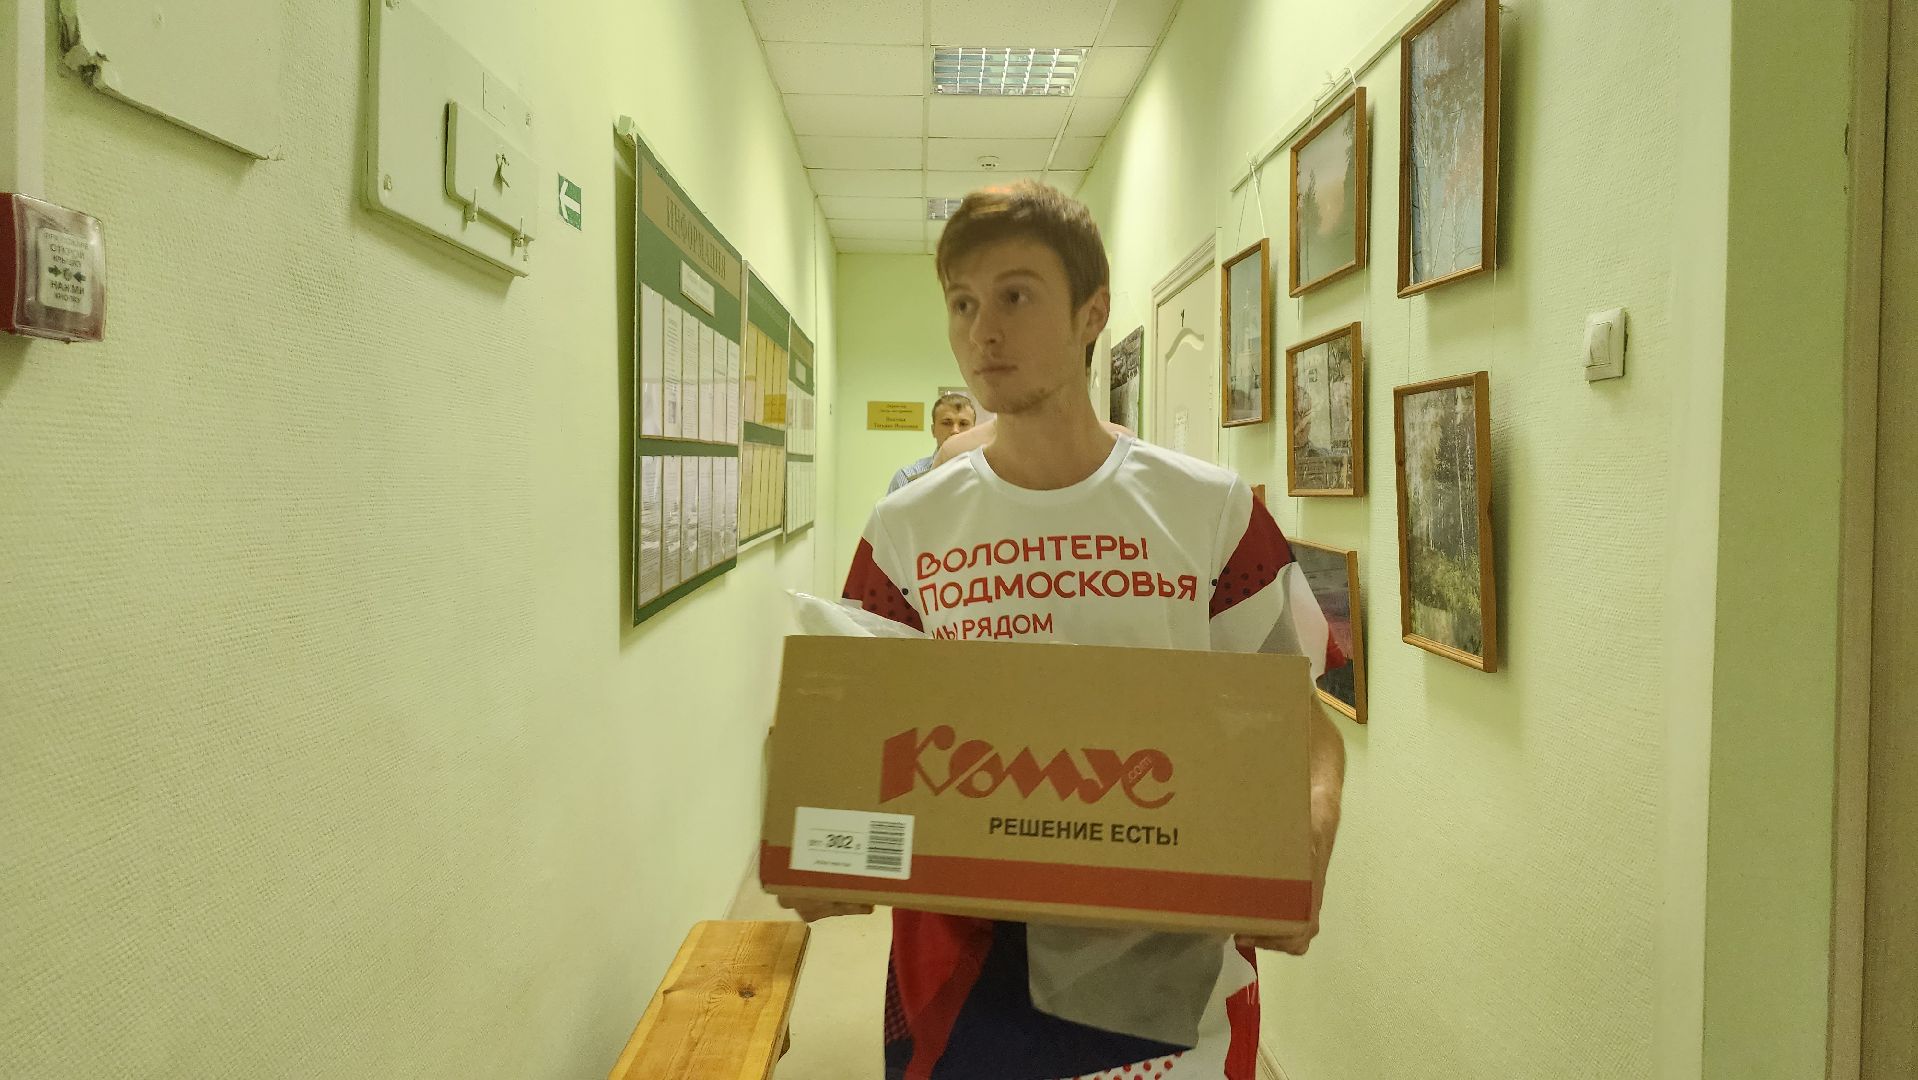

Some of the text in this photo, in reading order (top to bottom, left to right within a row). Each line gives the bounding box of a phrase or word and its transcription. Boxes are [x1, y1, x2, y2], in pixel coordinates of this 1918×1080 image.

[916, 534, 1149, 580] ВОЛОНТЕРЫ
[918, 569, 1198, 616] ПОДМОСКОВЬЯ
[962, 612, 1053, 640] РЯДОМ
[988, 816, 1179, 847] РЕШЕНИЕ ЕСТЬ!
